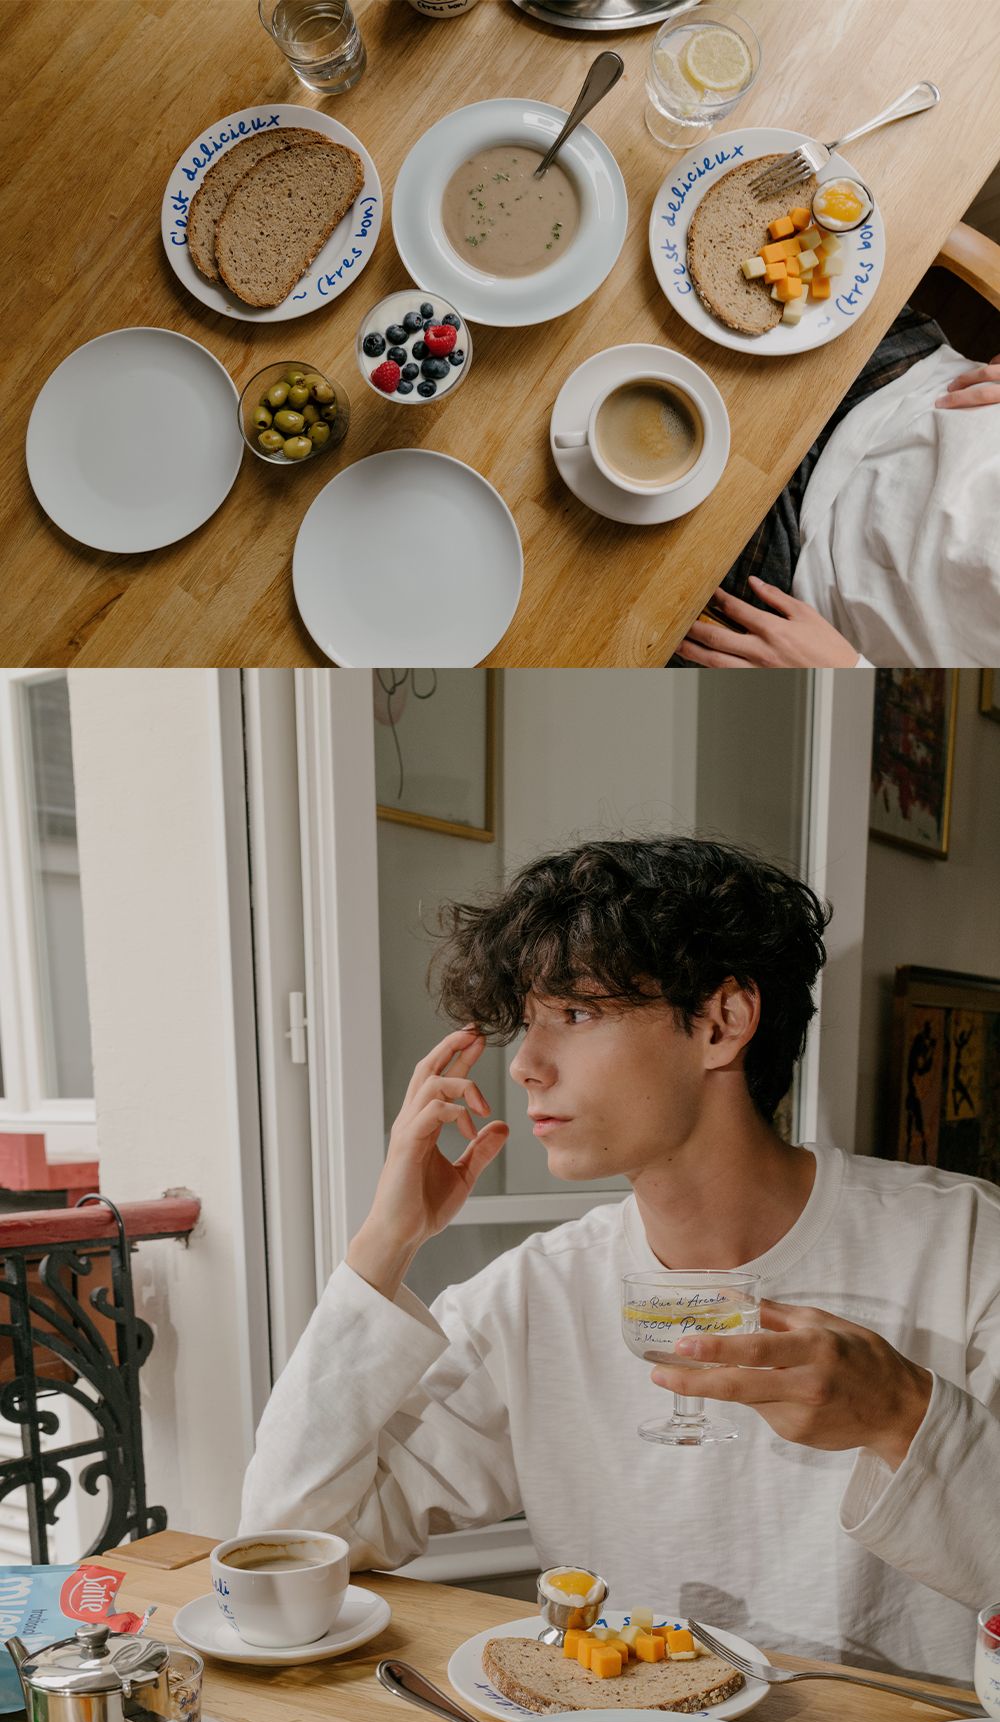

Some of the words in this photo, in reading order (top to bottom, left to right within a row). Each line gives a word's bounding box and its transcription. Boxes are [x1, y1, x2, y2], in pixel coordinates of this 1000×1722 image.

[182, 114, 280, 182] delicieux
[661, 144, 744, 227] delicieux
[355, 196, 378, 238] bon)
[660, 239, 693, 295] C'est
[638, 1319, 673, 1330] 75004
[650, 1296, 672, 1308] Rue
